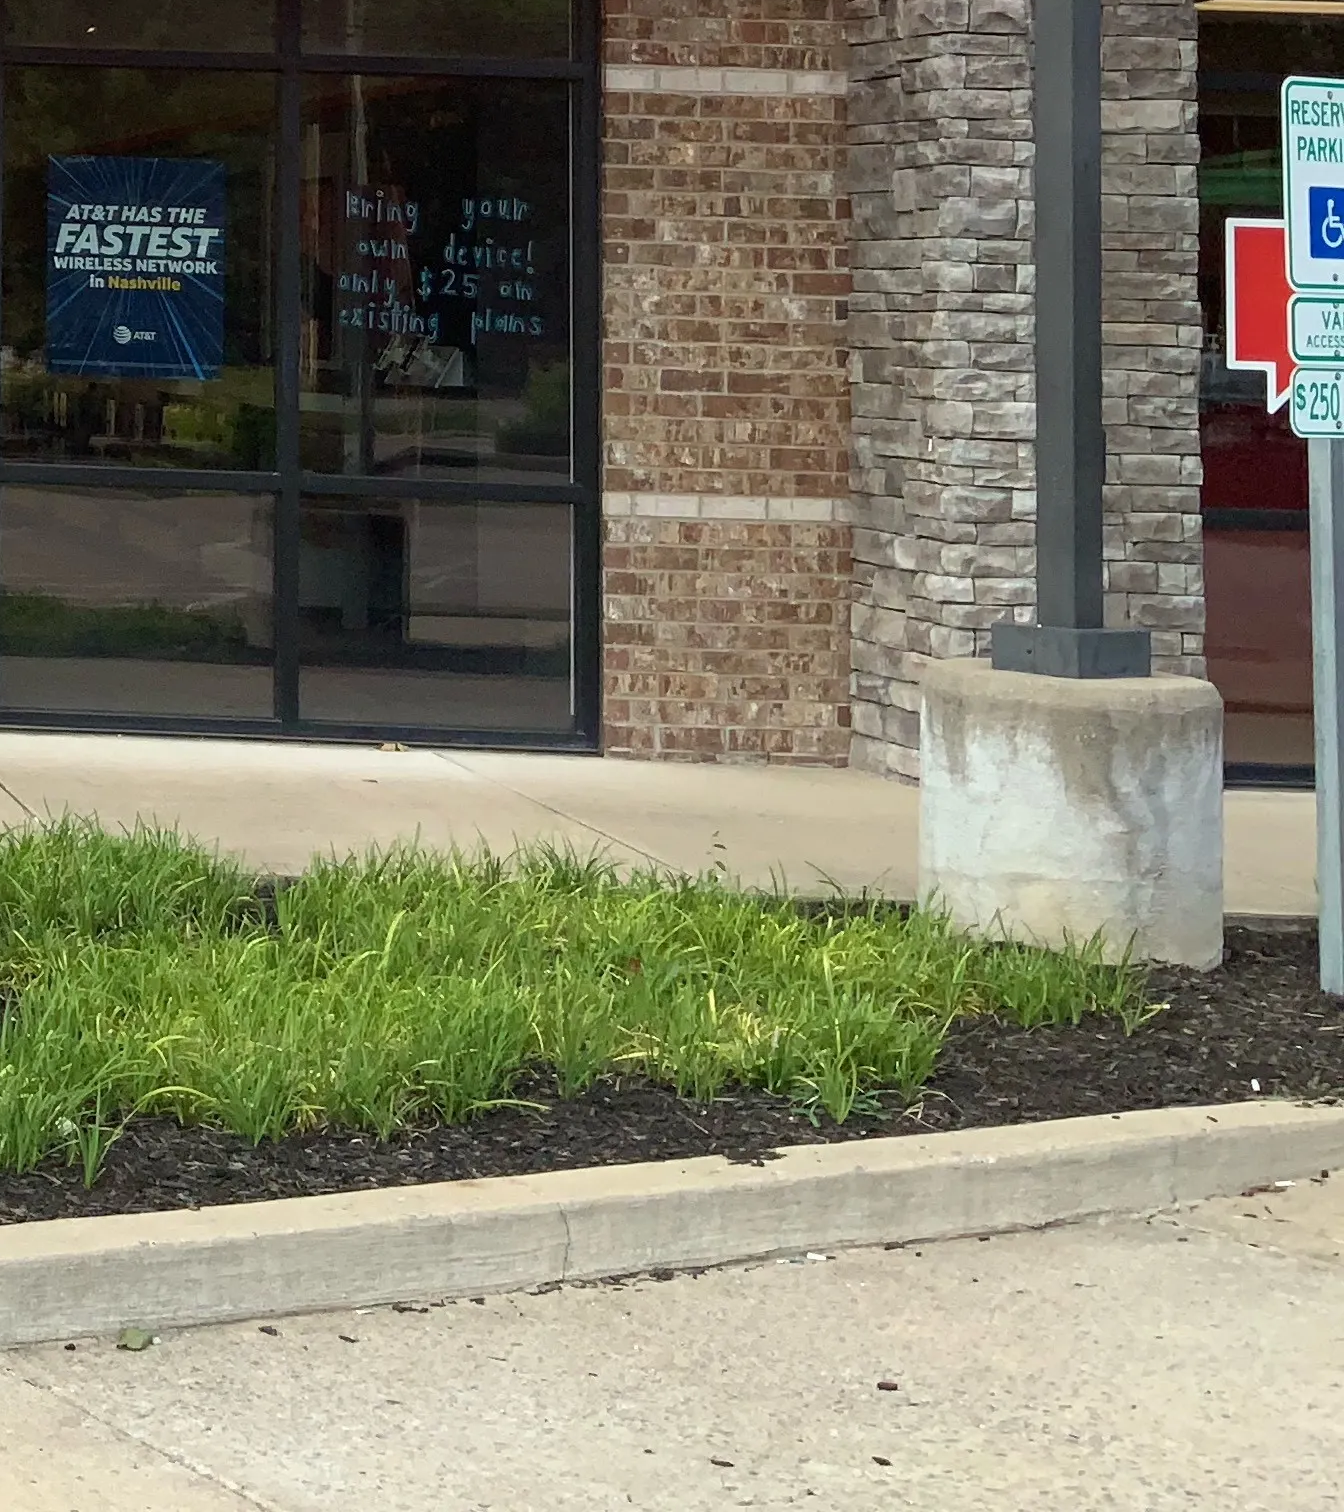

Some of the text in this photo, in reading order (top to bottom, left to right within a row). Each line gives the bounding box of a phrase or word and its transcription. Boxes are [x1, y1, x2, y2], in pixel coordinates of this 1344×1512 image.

[65, 204, 207, 224] AT&T HAS THE
[462, 198, 530, 230] your
[55, 223, 219, 258] FASTEST
[357, 233, 535, 274] own device!
[53, 256, 218, 275] WIRELESS NETWORK
[89, 274, 181, 291] in Nashville
[417, 266, 480, 301] $25
[133, 331, 157, 340] AT&T
[339, 301, 543, 345] existing plans
